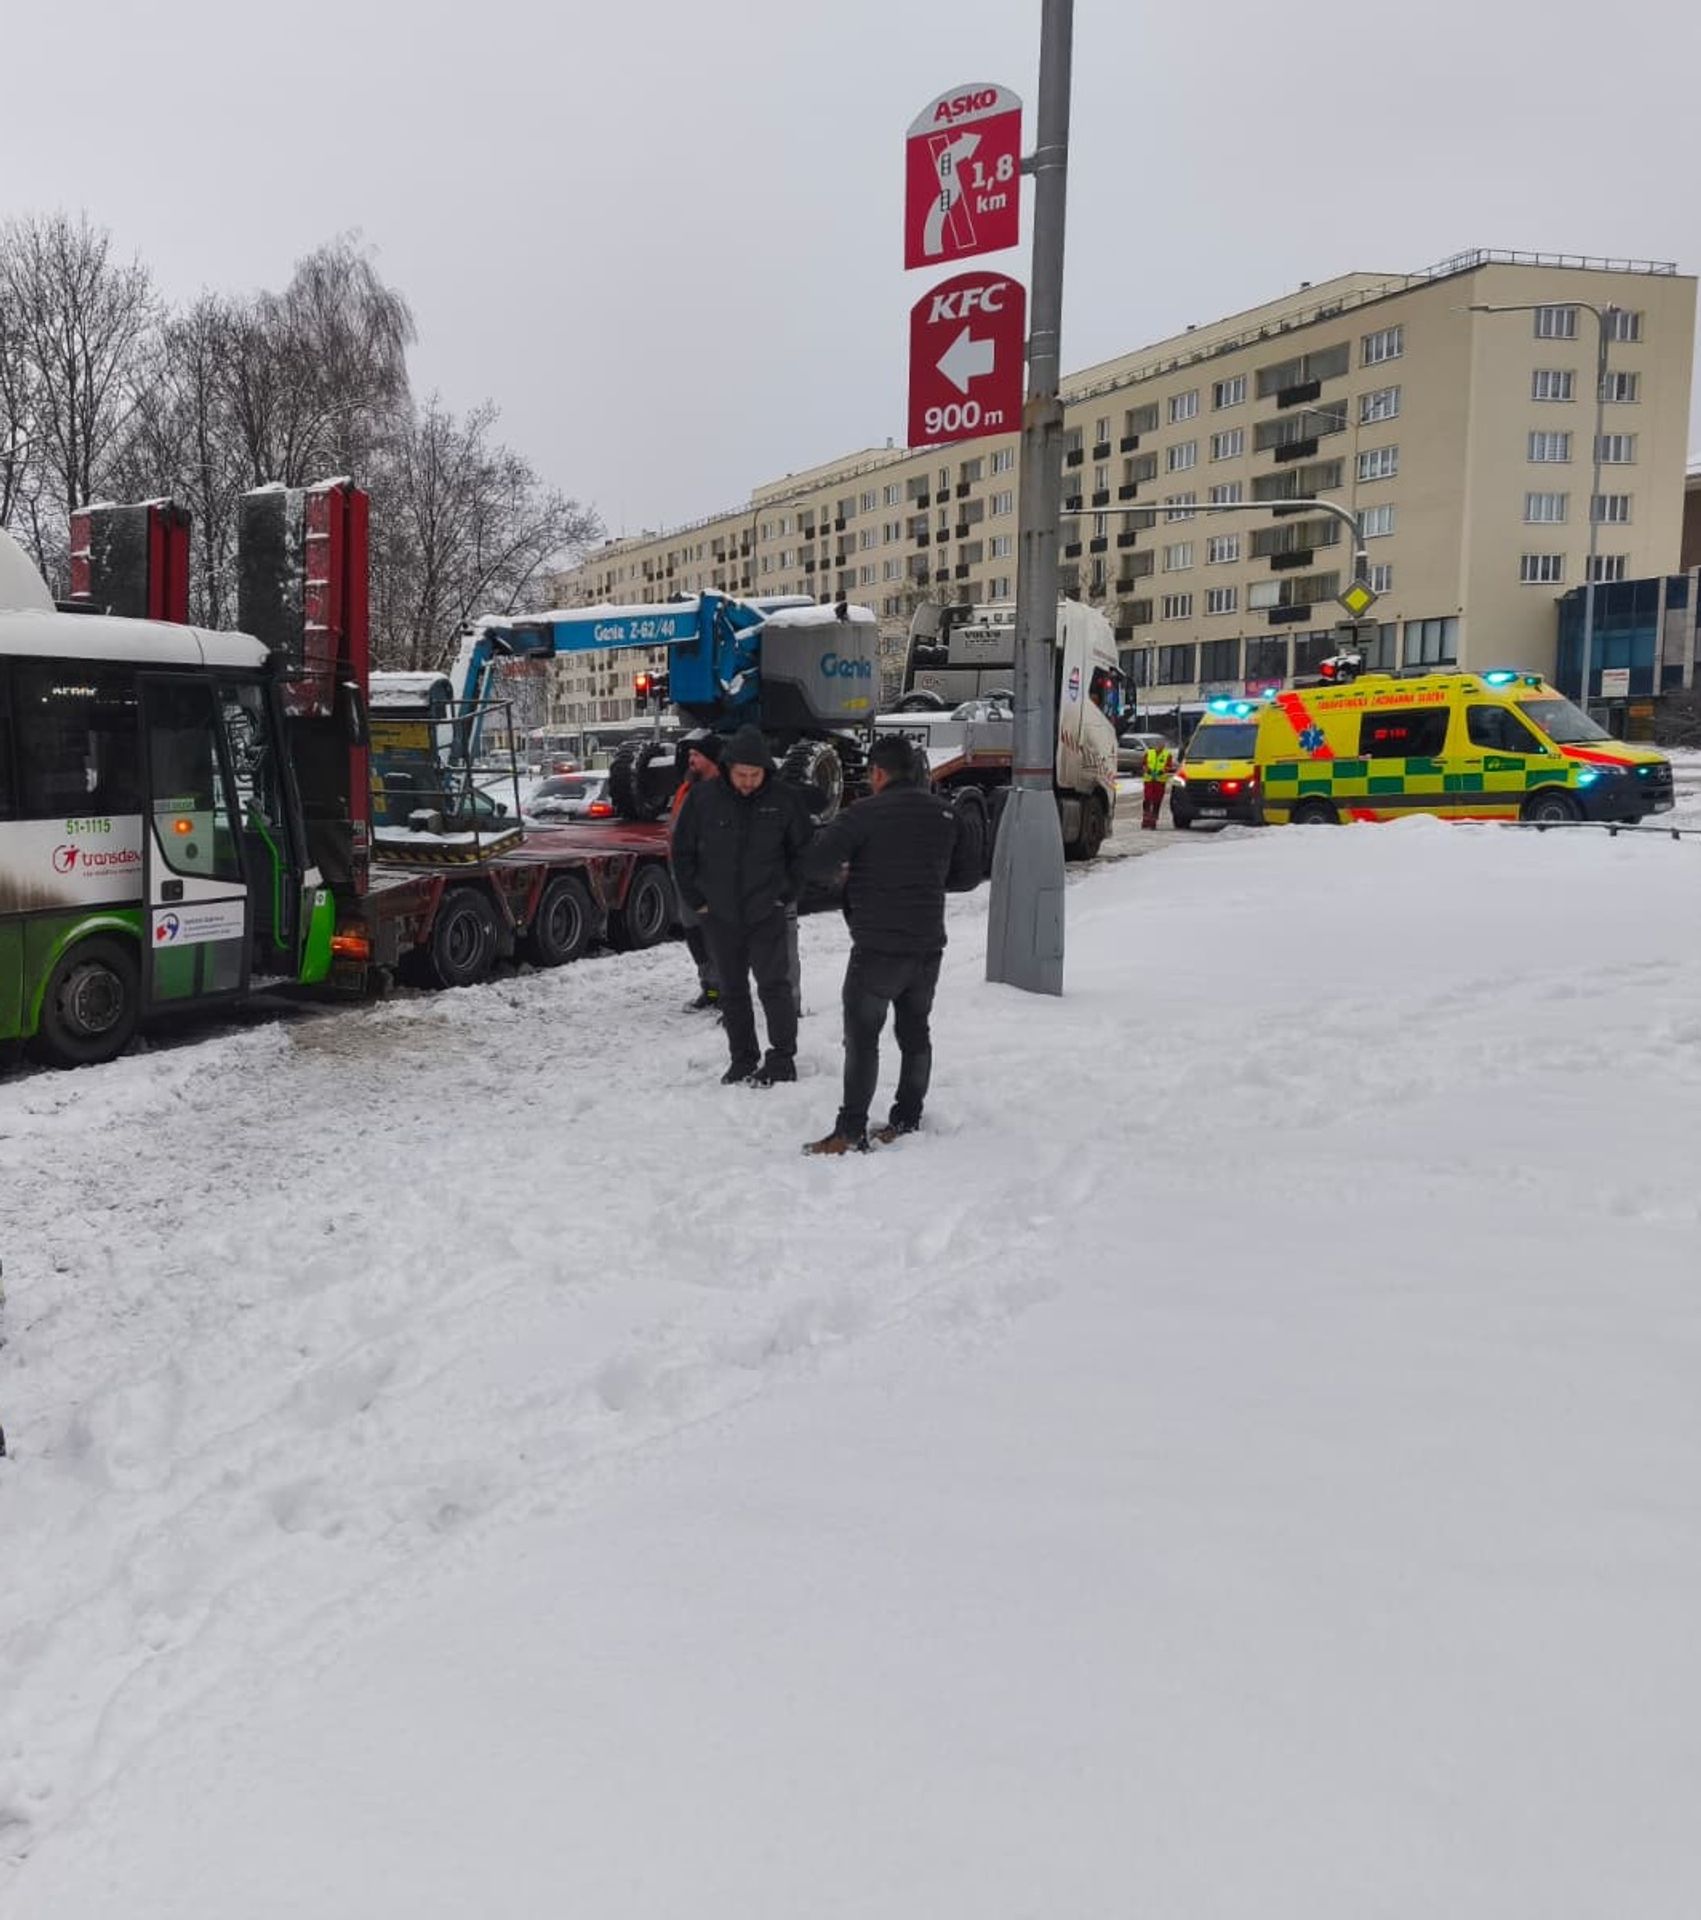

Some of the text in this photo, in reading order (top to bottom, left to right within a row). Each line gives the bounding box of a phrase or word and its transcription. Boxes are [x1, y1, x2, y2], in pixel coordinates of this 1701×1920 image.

[971, 154, 1014, 191] 1,8
[976, 194, 1007, 215] km
[927, 282, 1008, 324] KFC
[924, 401, 1004, 434] 900 m
[820, 652, 872, 680] Genie
[66, 818, 112, 835] 51-1115
